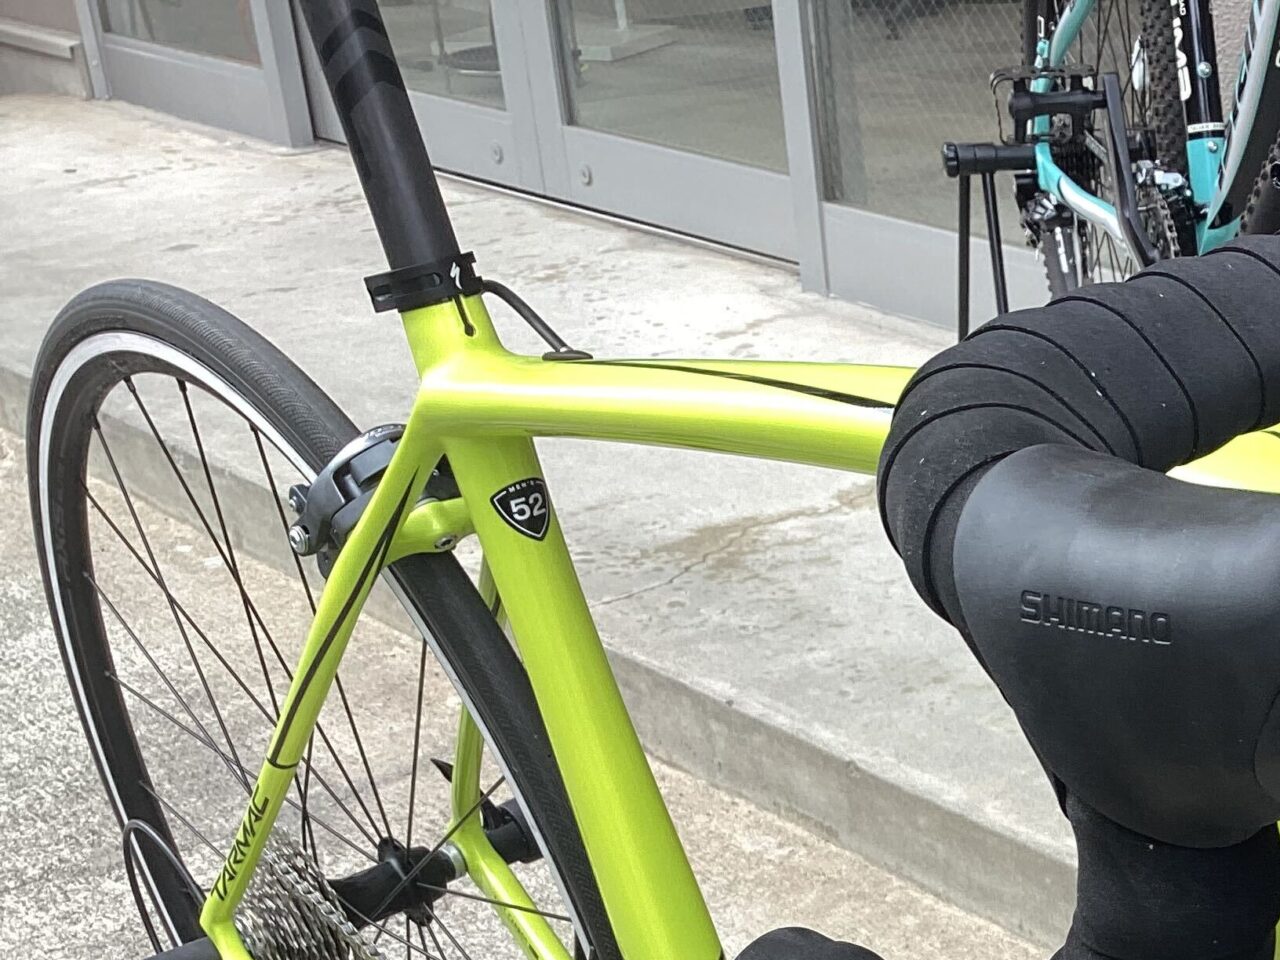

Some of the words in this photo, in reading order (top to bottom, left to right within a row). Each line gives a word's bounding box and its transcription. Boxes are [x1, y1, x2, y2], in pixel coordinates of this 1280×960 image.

[509, 492, 547, 521] 52
[1020, 589, 1172, 646] SHIMANO
[210, 784, 270, 901] TARMAC
